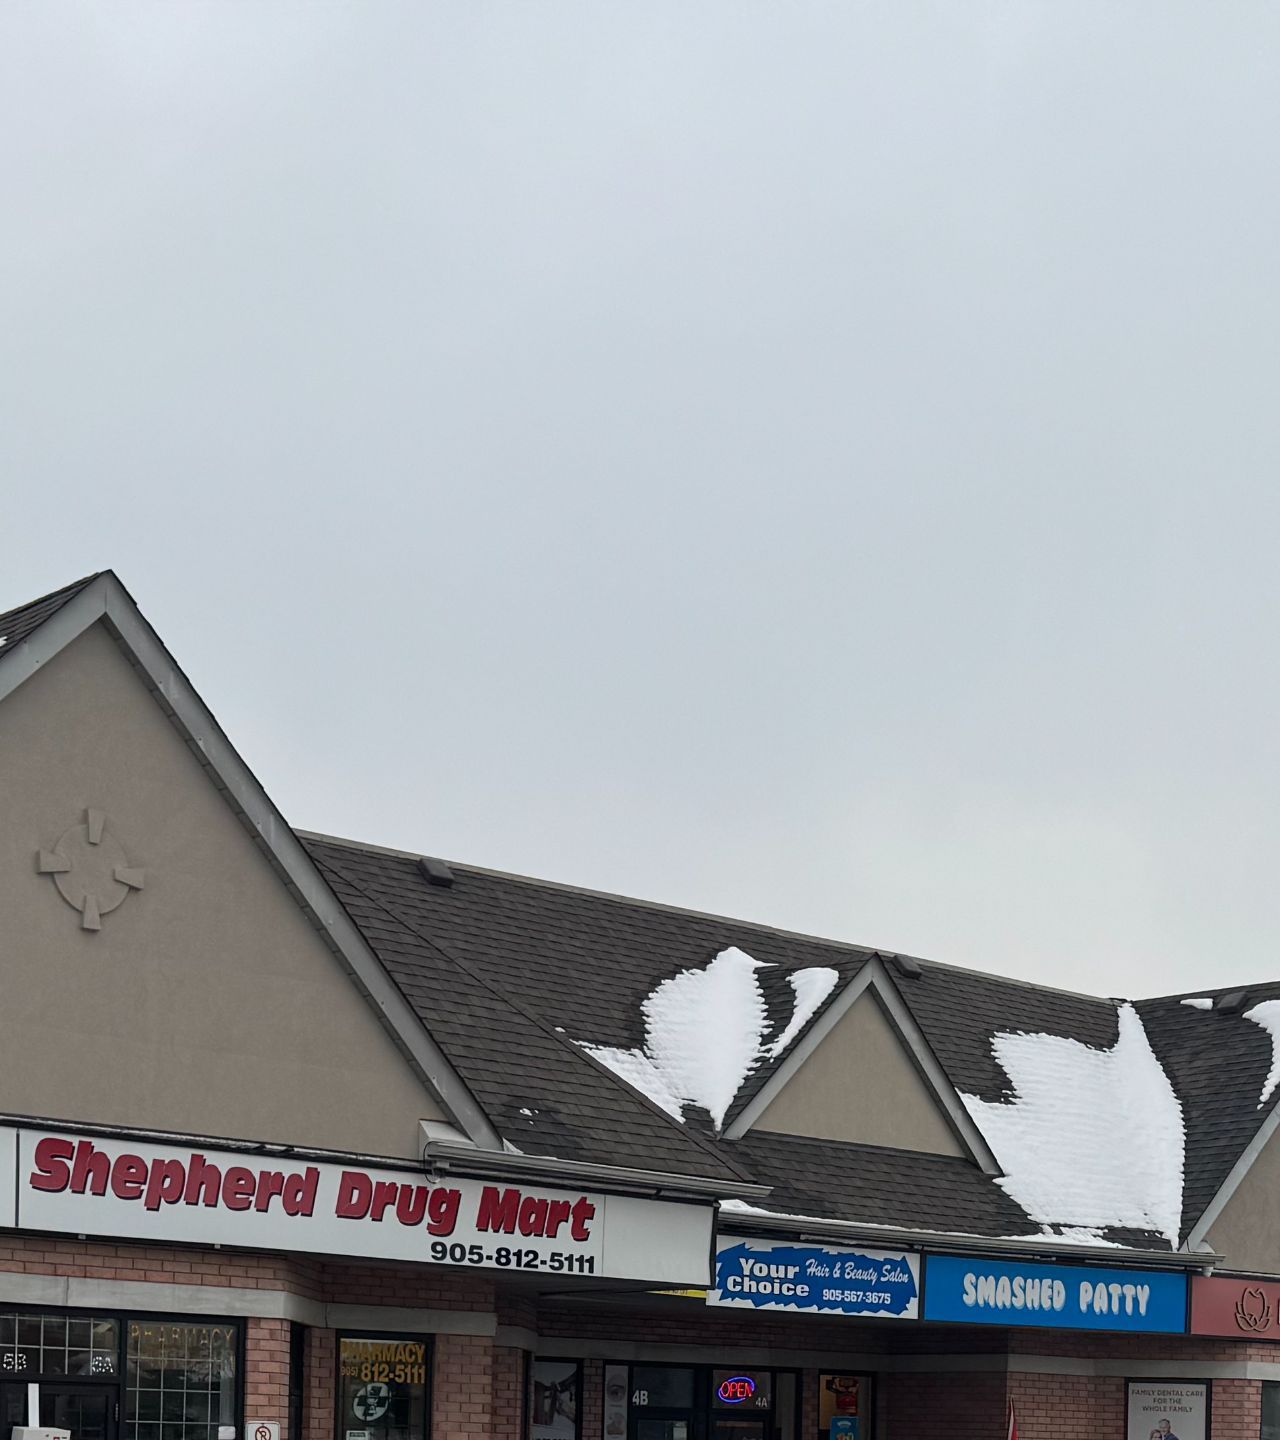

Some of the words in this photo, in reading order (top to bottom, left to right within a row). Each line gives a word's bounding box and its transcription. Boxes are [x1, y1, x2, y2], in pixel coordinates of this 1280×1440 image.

[29, 1137, 320, 1217] Shepherd
[335, 1171, 462, 1238] Drug
[475, 1186, 596, 1242] Mart
[429, 1241, 595, 1275] 905-812-5111
[739, 1257, 800, 1279] Your
[805, 1258, 830, 1278] Hair
[833, 1262, 841, 1278] &
[844, 1262, 879, 1284] Beauty
[880, 1264, 909, 1284] Salon
[726, 1275, 810, 1297] Choice
[822, 1289, 891, 1304] 905-567-3675
[962, 1272, 1066, 1312] SMASHED
[1079, 1281, 1150, 1317] PATTY
[361, 1363, 426, 1384] 812-5111
[632, 1390, 649, 1405] 4B
[720, 1381, 753, 1397] OPEN
[755, 1397, 768, 1407] 4A
